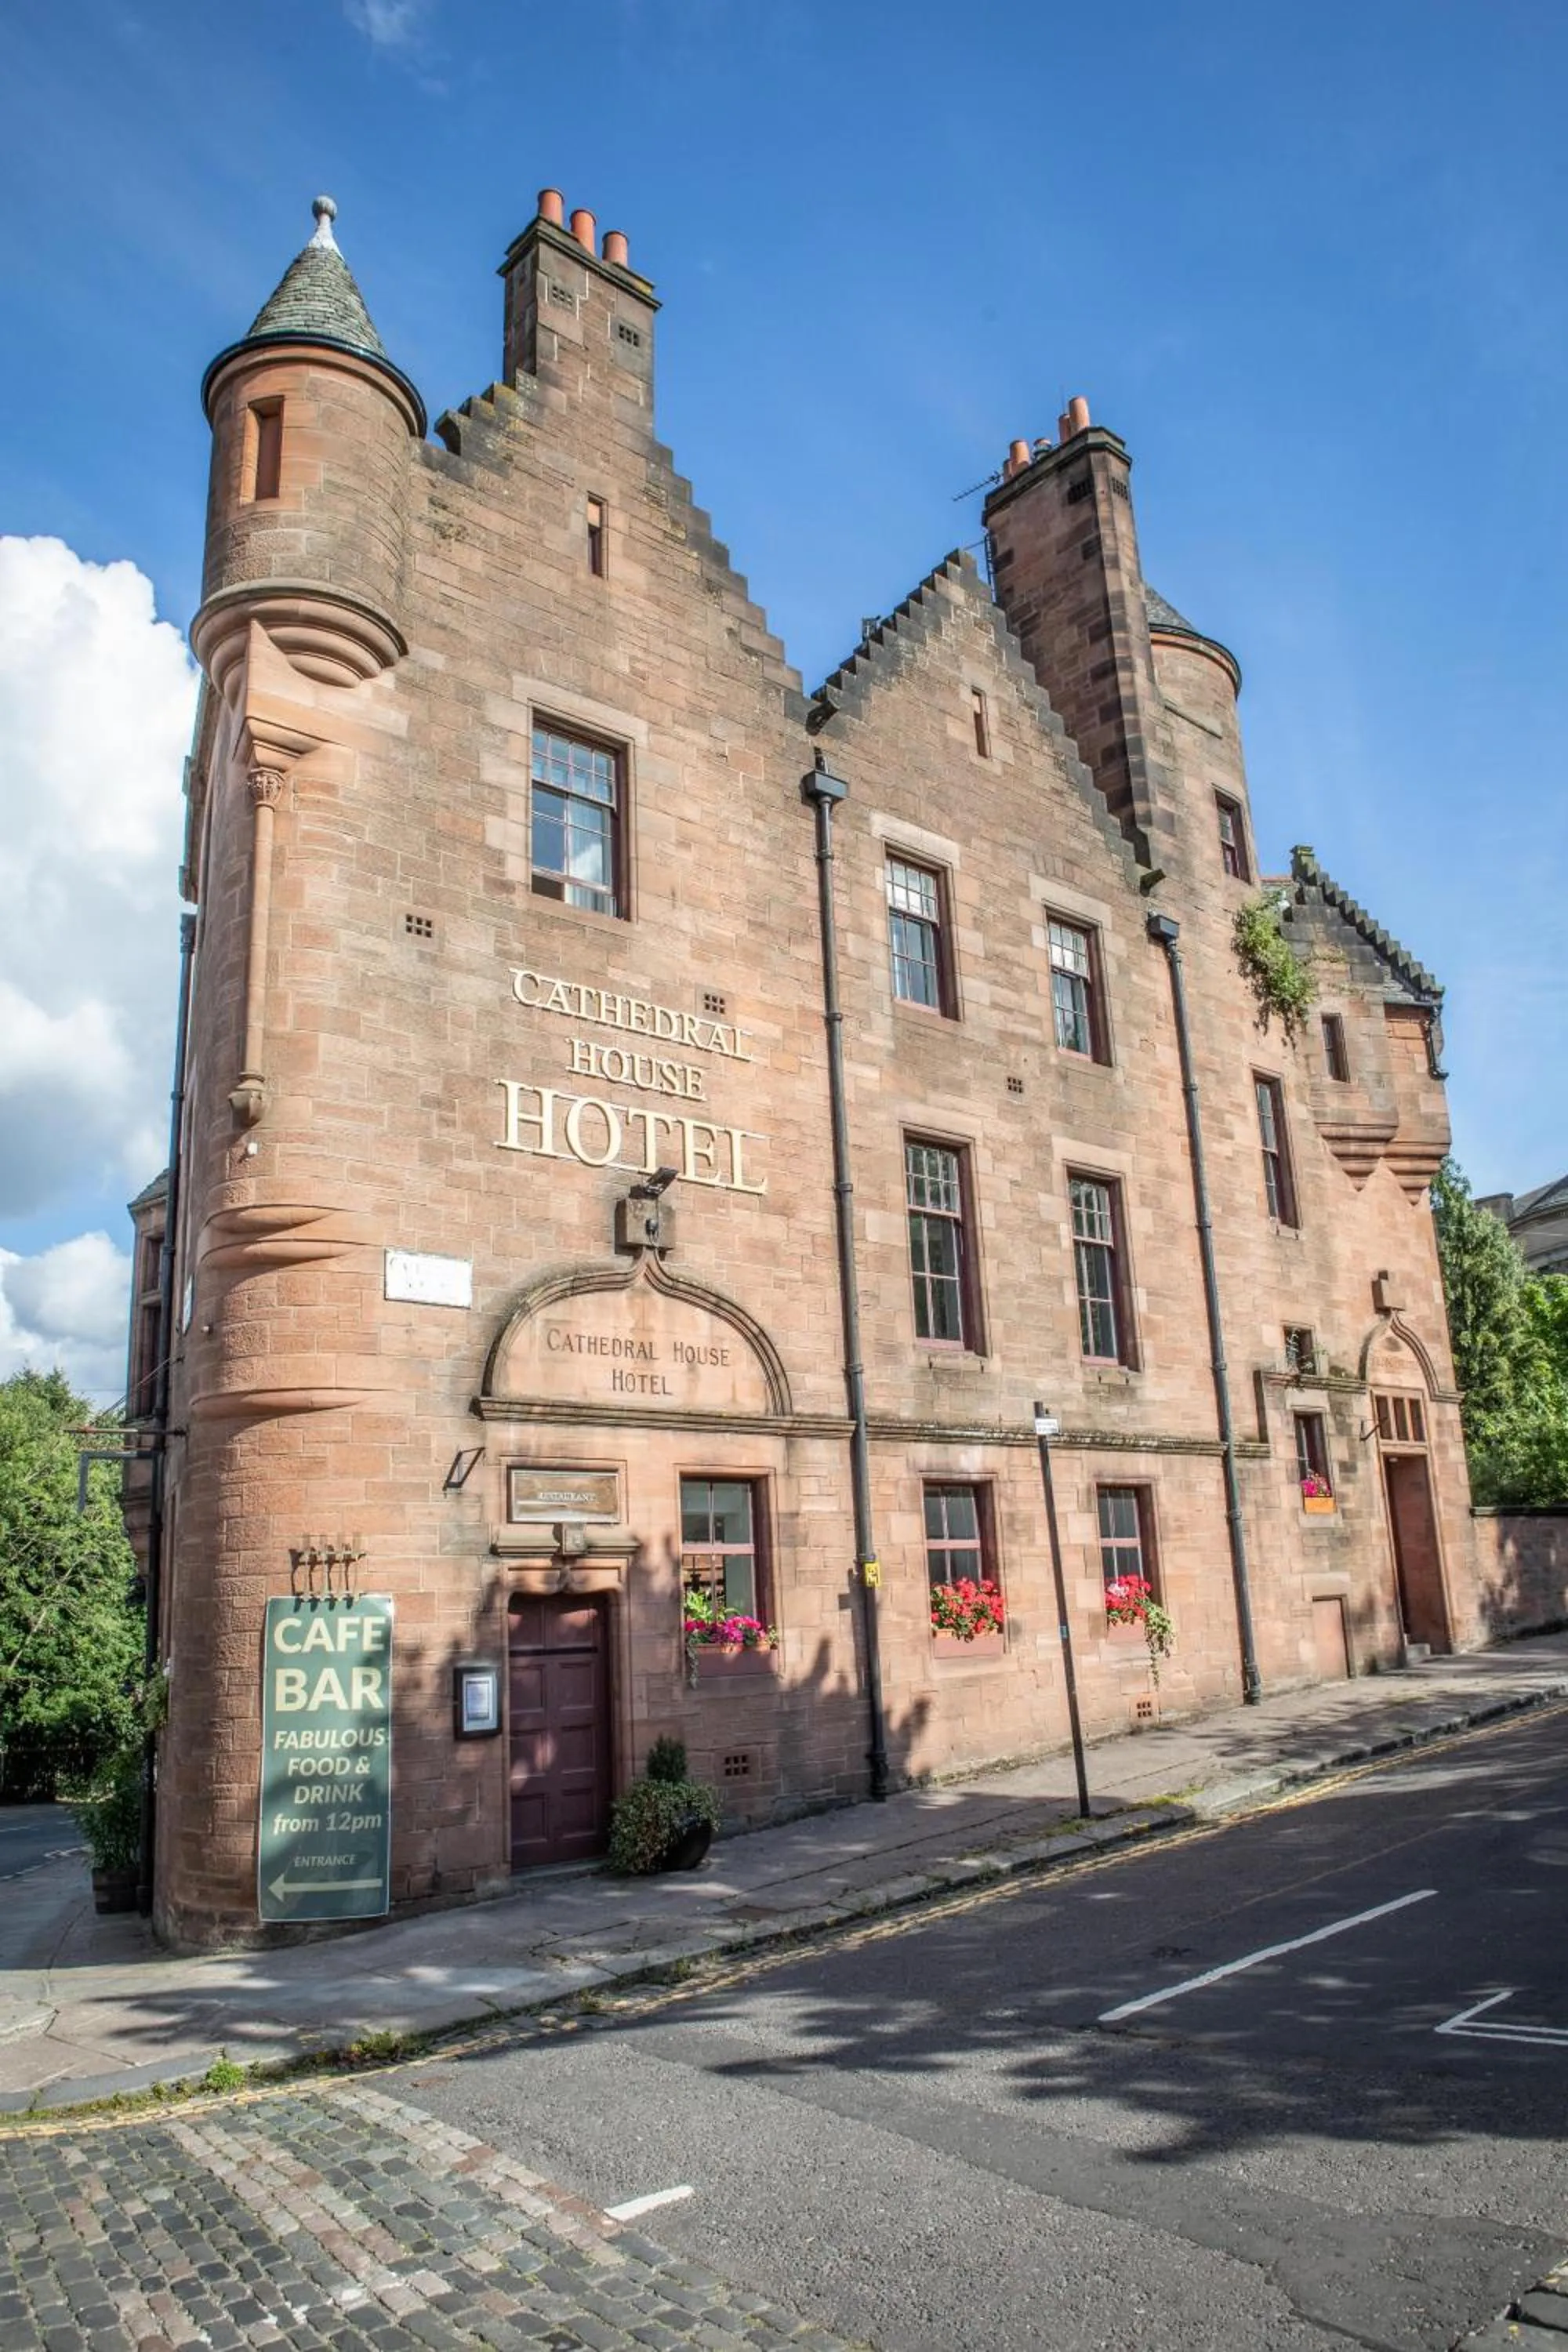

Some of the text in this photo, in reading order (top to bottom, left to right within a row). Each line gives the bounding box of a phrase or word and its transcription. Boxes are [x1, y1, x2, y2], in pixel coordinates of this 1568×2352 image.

[511, 970, 754, 1061] CATHEDRAL
[567, 1039, 706, 1101] HOUSE
[495, 1079, 768, 1194] HOTEL
[546, 1328, 731, 1367] CATHEDRAL HOUSE
[612, 1368, 673, 1396] HOTEL
[274, 1616, 386, 1654] CAFE
[274, 1667, 385, 1711] BAR
[274, 1727, 386, 1751] FABULOUS
[288, 1755, 371, 1777] FOOD &
[294, 1782, 365, 1805] DRINK
[273, 1811, 383, 1836] from 12pm
[293, 1853, 358, 1867] ENTRANCE
